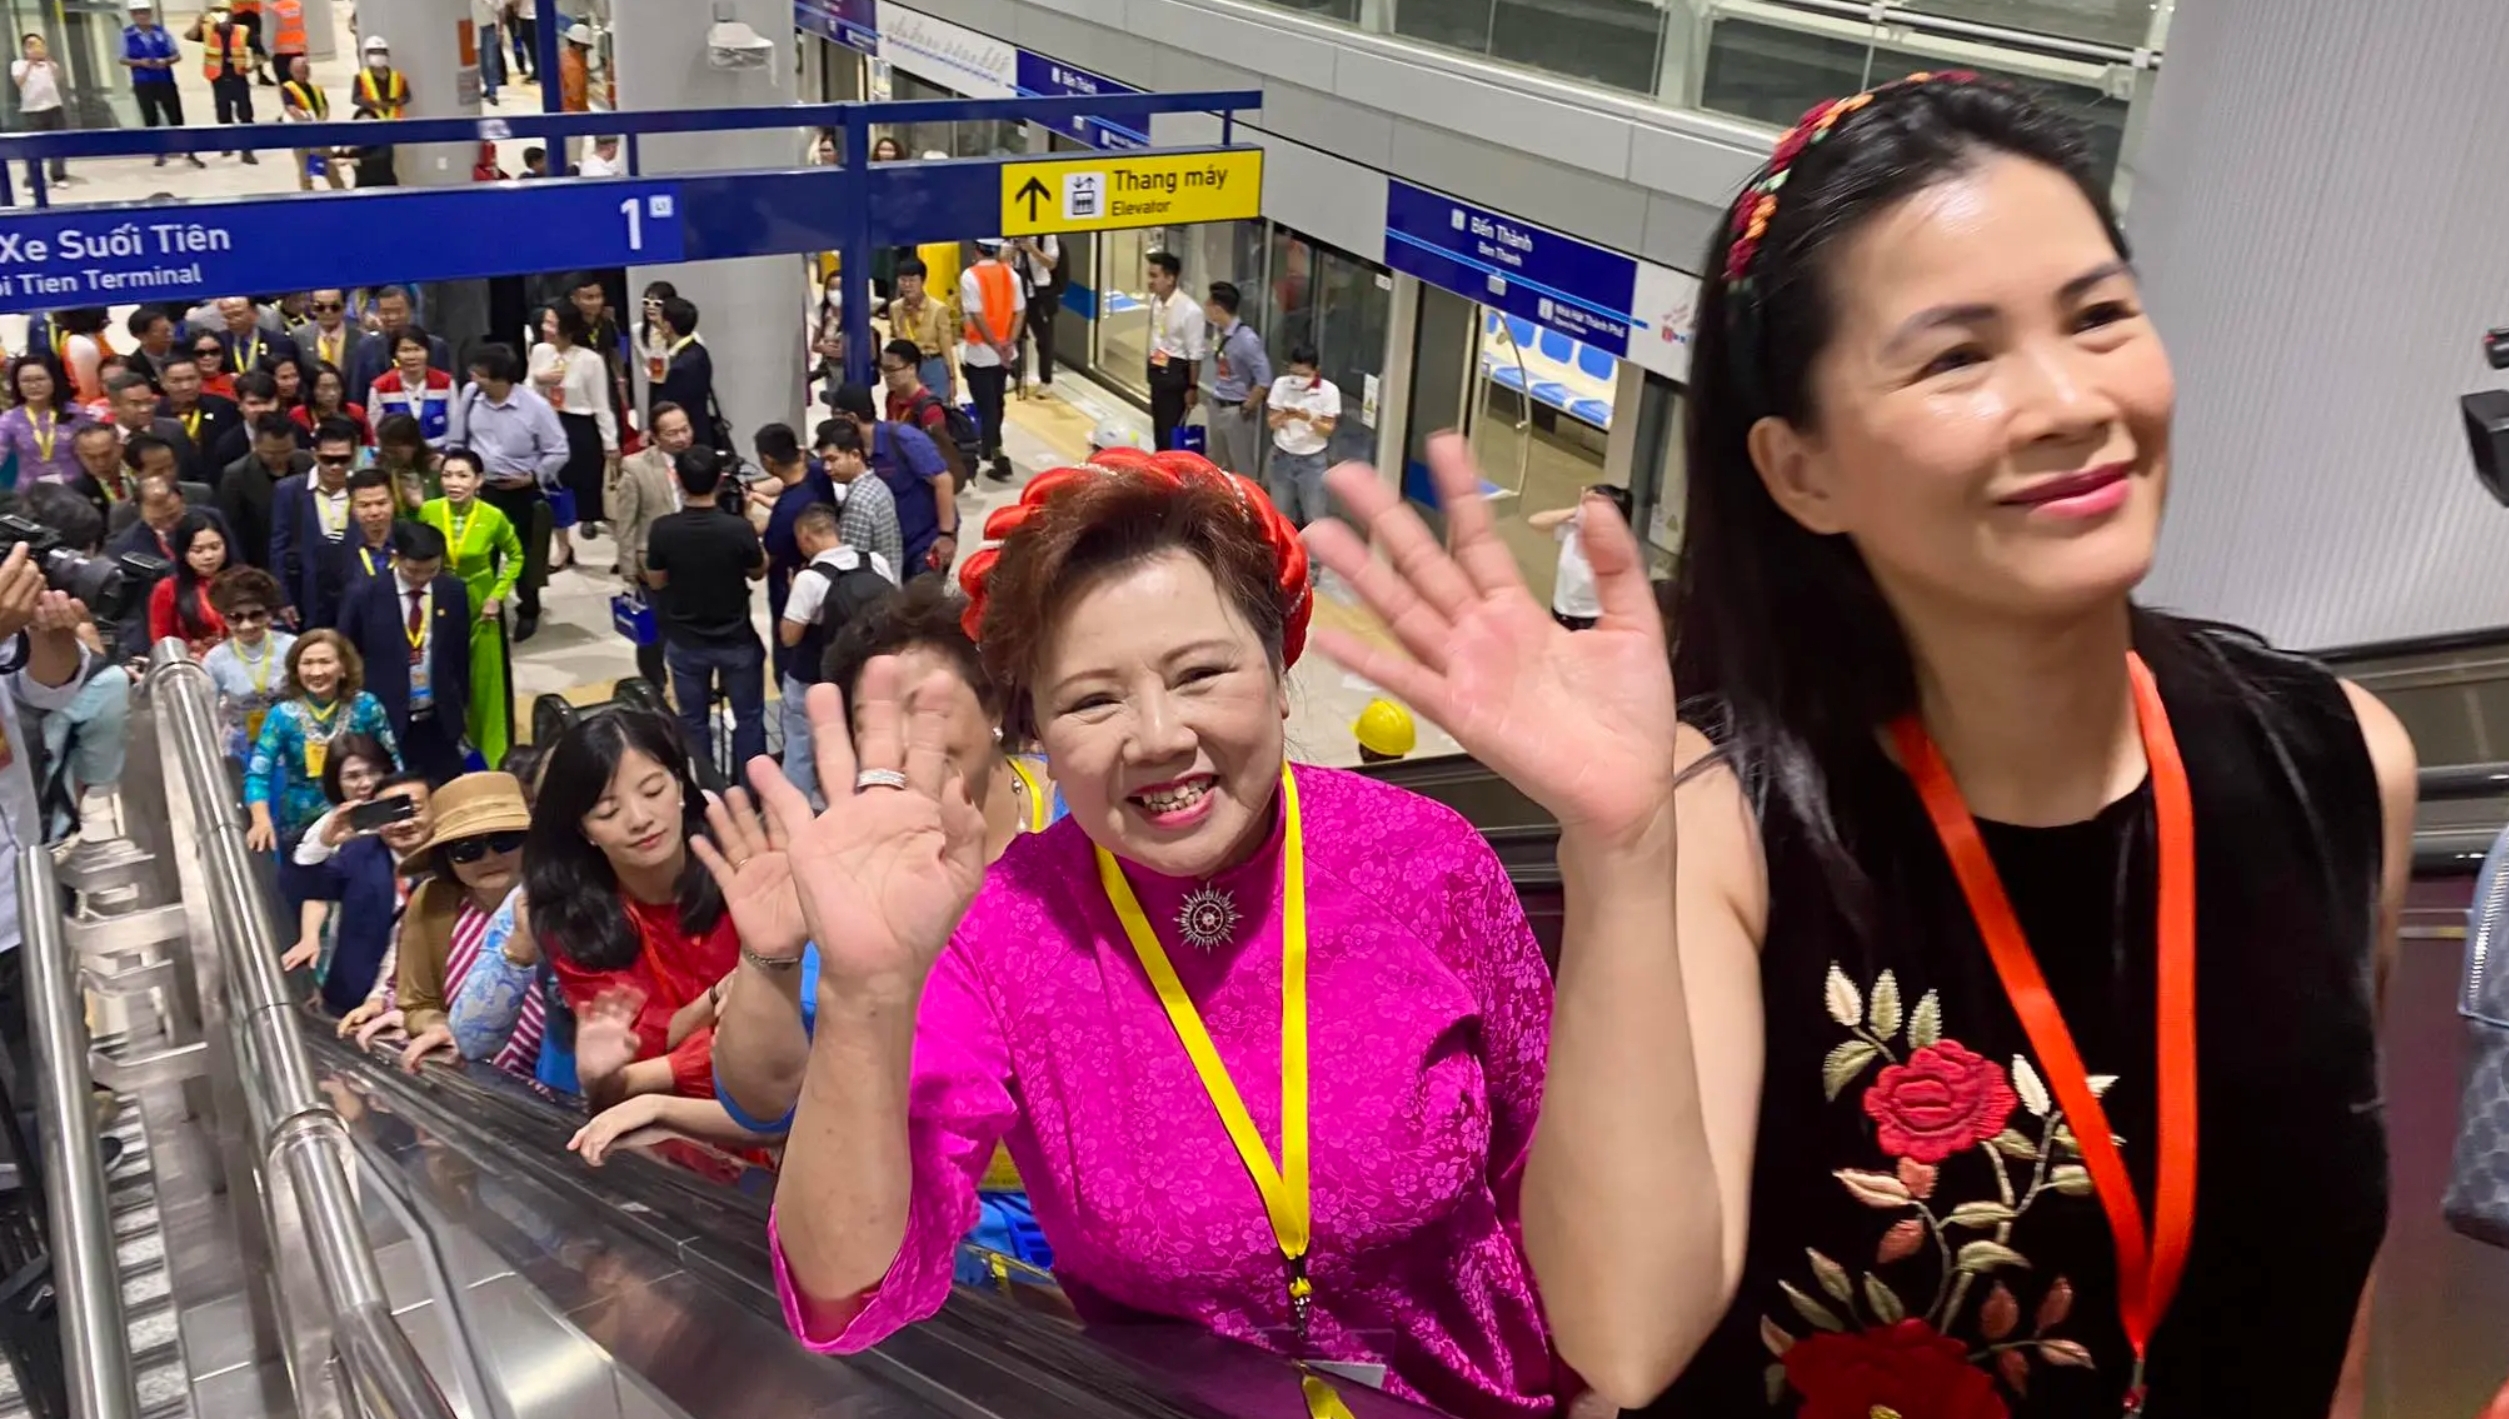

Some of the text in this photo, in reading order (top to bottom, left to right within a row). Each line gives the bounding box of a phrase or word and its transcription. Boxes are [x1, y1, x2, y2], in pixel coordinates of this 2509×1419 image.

[1113, 164, 1228, 193] Thang máy
[620, 198, 642, 250] 1
[1111, 200, 1171, 216] Elevator
[0, 223, 231, 263] Xe Suối Tiên
[1471, 216, 1494, 239] Bến
[1496, 224, 1533, 253] Thành
[15, 272, 79, 295] Tien
[81, 262, 203, 290] Terminal
